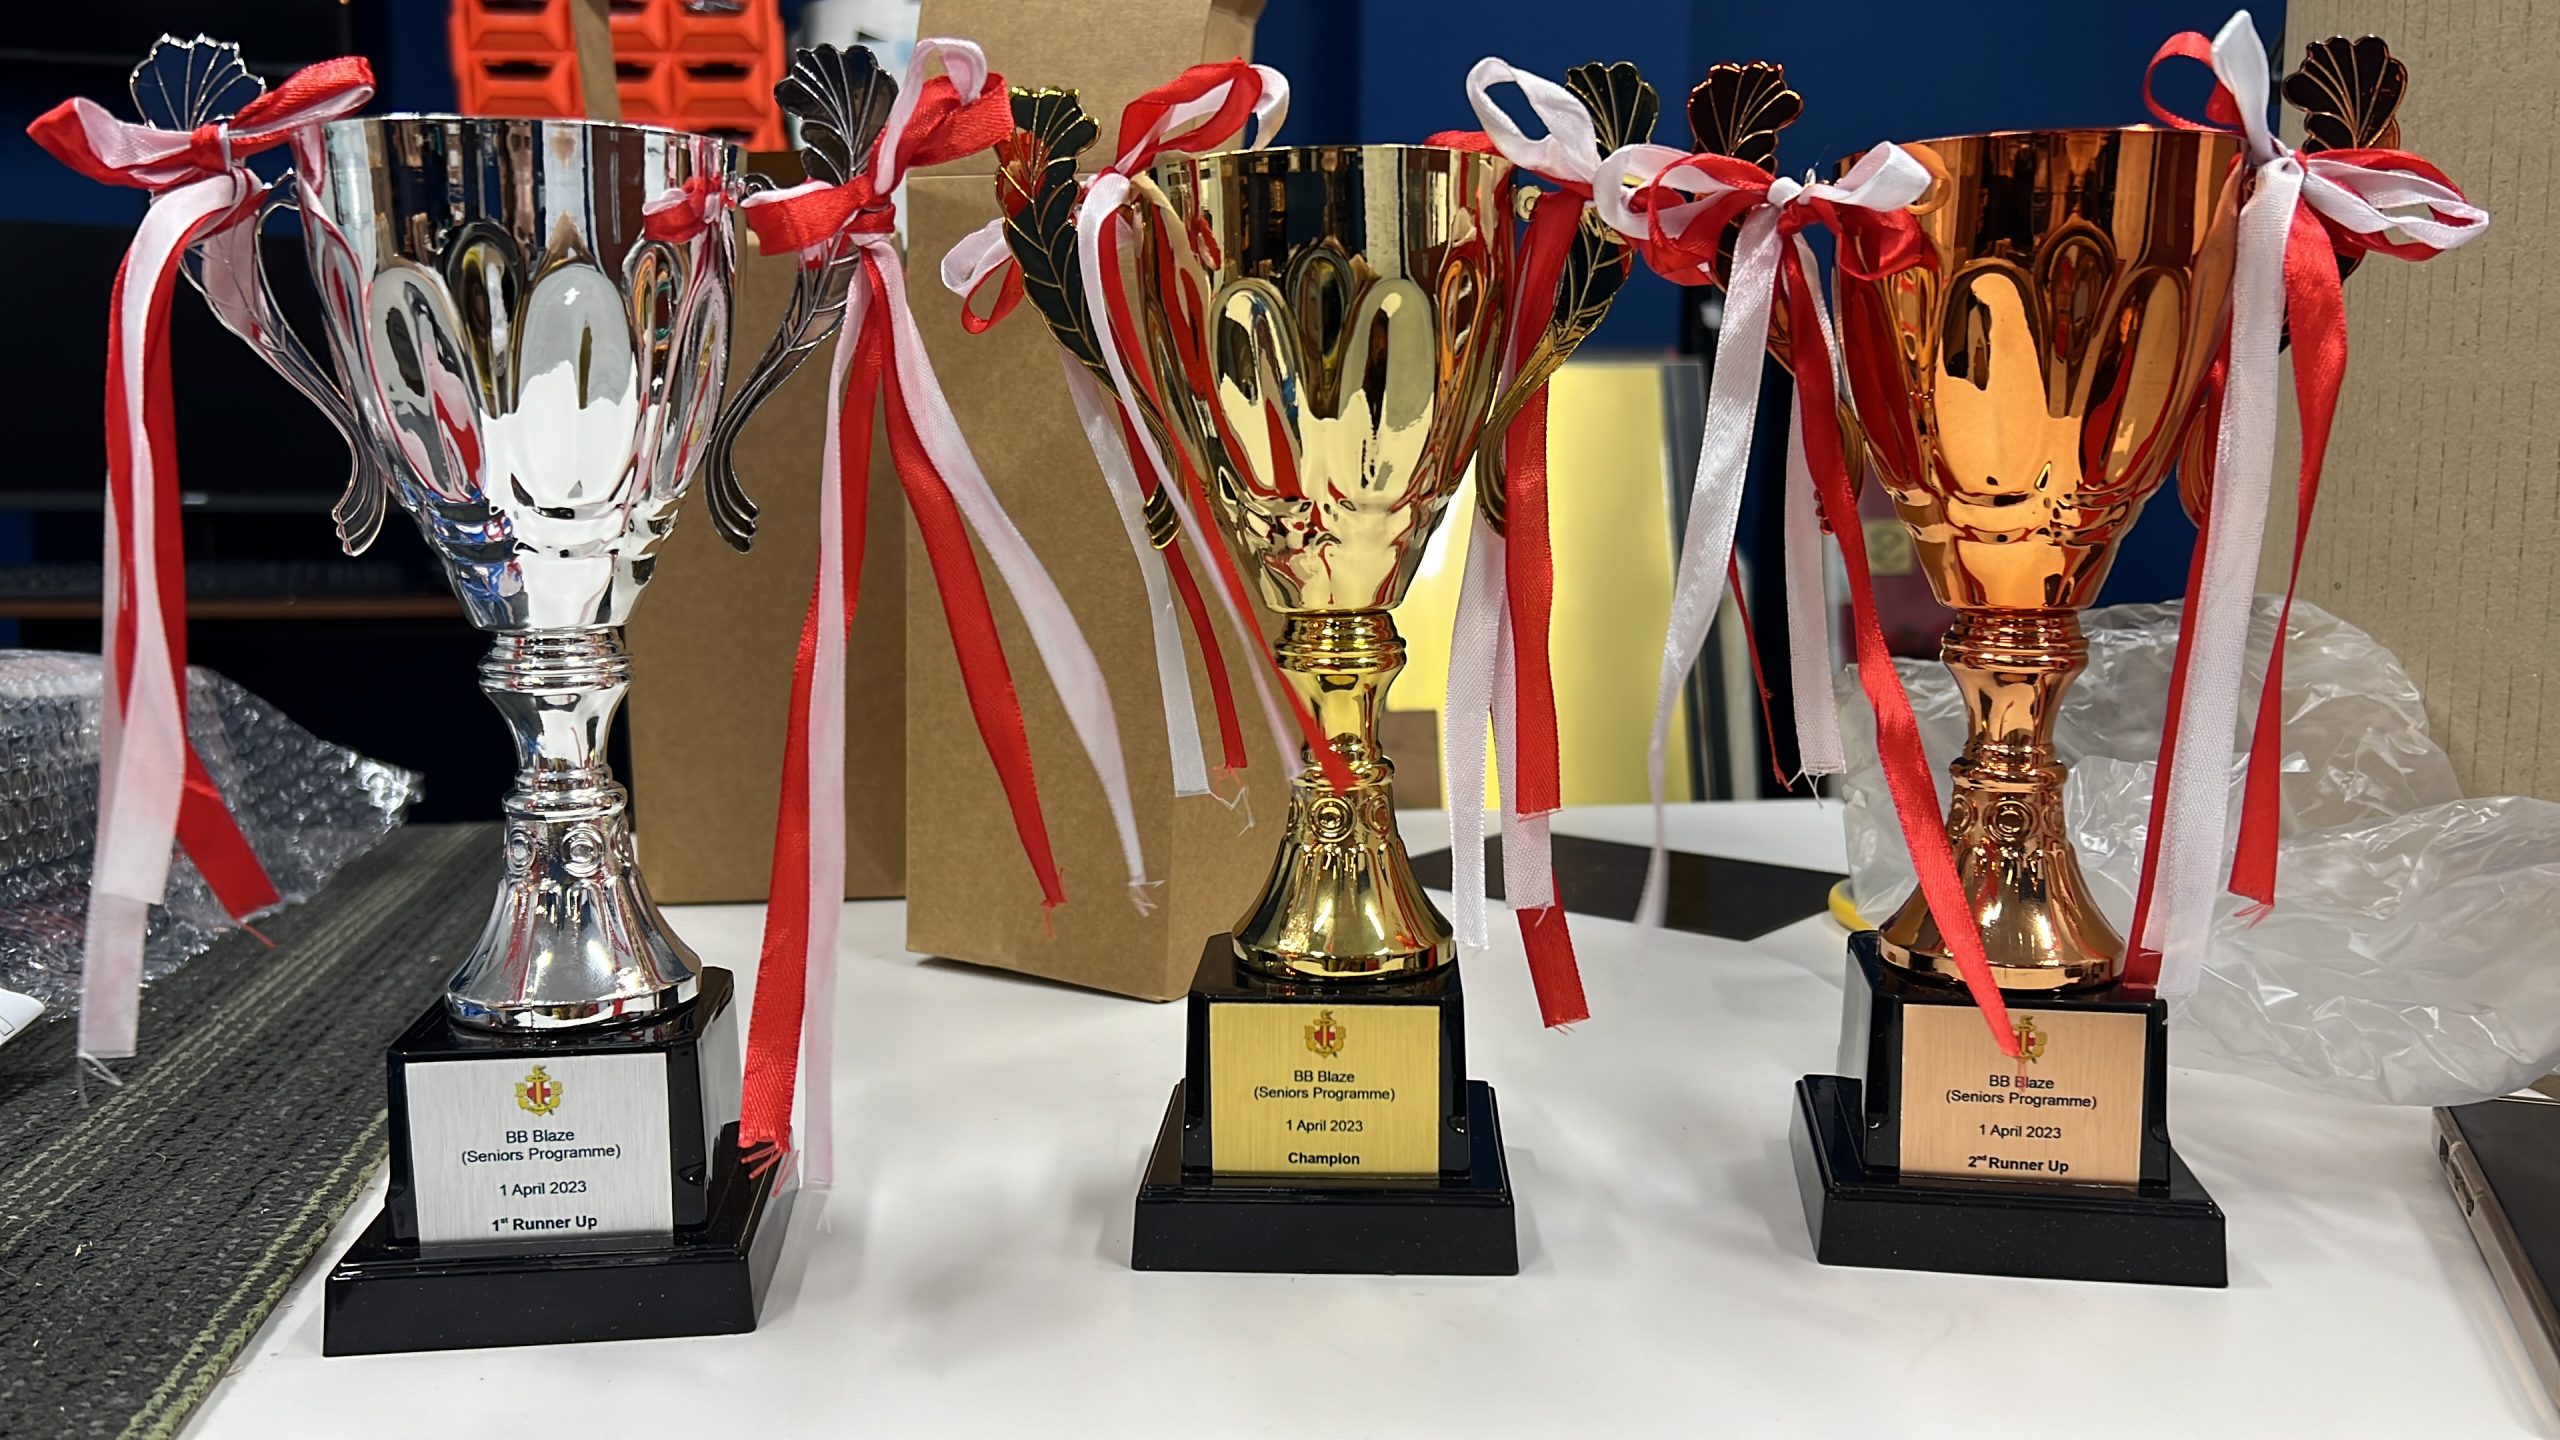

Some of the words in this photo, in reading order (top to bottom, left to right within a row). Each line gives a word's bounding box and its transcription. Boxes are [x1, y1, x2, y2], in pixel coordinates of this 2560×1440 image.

[1293, 1070, 1315, 1083] BB
[1317, 1069, 1356, 1084] Blaze
[1989, 1074, 2011, 1088] BB
[2014, 1075, 2055, 1090] Blaze
[1253, 1086, 1310, 1100] (Seniors
[1313, 1087, 1395, 1101] Programme)
[1945, 1089, 2006, 1105] (Seniors
[2009, 1092, 2097, 1109] Programme)
[1286, 1119, 1292, 1131] 1
[1296, 1118, 1327, 1134] April
[1329, 1119, 1364, 1133] 2023
[1979, 1123, 1986, 1136] 1
[1989, 1124, 2023, 1140] April
[2025, 1125, 2062, 1140] 2023
[505, 1130, 529, 1144] BB
[532, 1129, 575, 1143] Blaze
[461, 1149, 525, 1166] (Seniors
[528, 1143, 622, 1162] Programme)
[1287, 1151, 1361, 1167] Champion
[1988, 1156, 2044, 1172] Runner
[2047, 1159, 2070, 1176] Up
[499, 1183, 507, 1197] 1
[511, 1182, 546, 1198] April
[549, 1180, 588, 1195] 2023
[512, 1217, 572, 1231] Runner
[575, 1214, 598, 1230] Up
